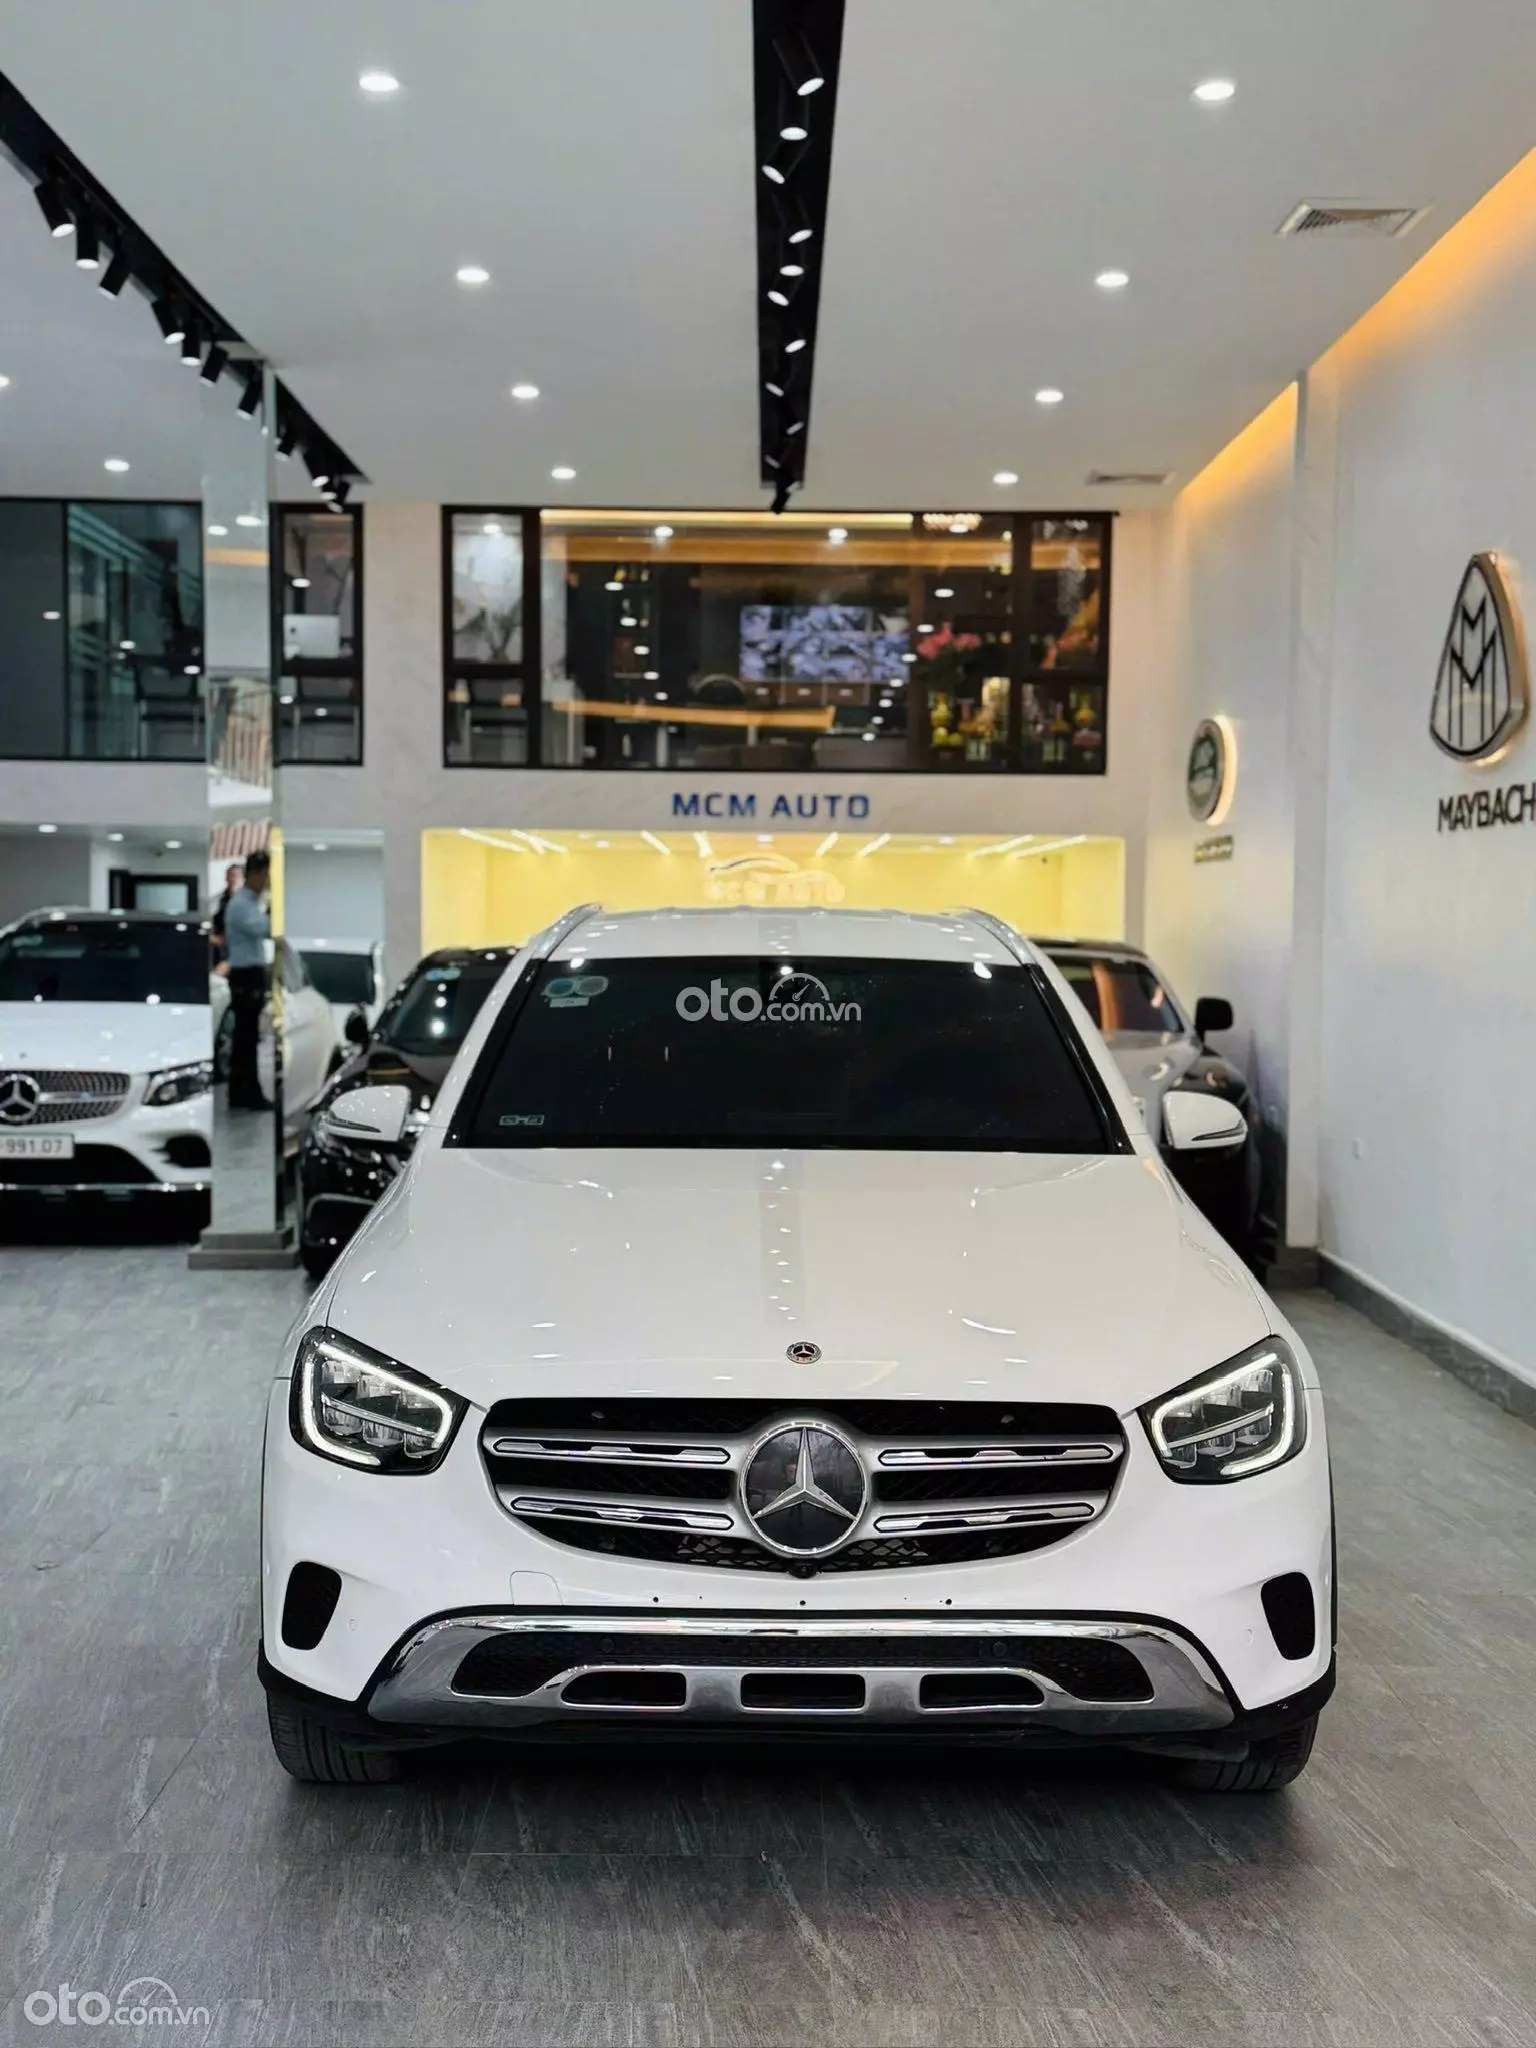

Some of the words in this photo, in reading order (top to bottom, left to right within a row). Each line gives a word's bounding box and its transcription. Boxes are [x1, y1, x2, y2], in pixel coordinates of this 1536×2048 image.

[673, 793, 756, 817] MCM
[771, 795, 869, 818] AUTO
[1437, 781, 1536, 833] MAYBACH
